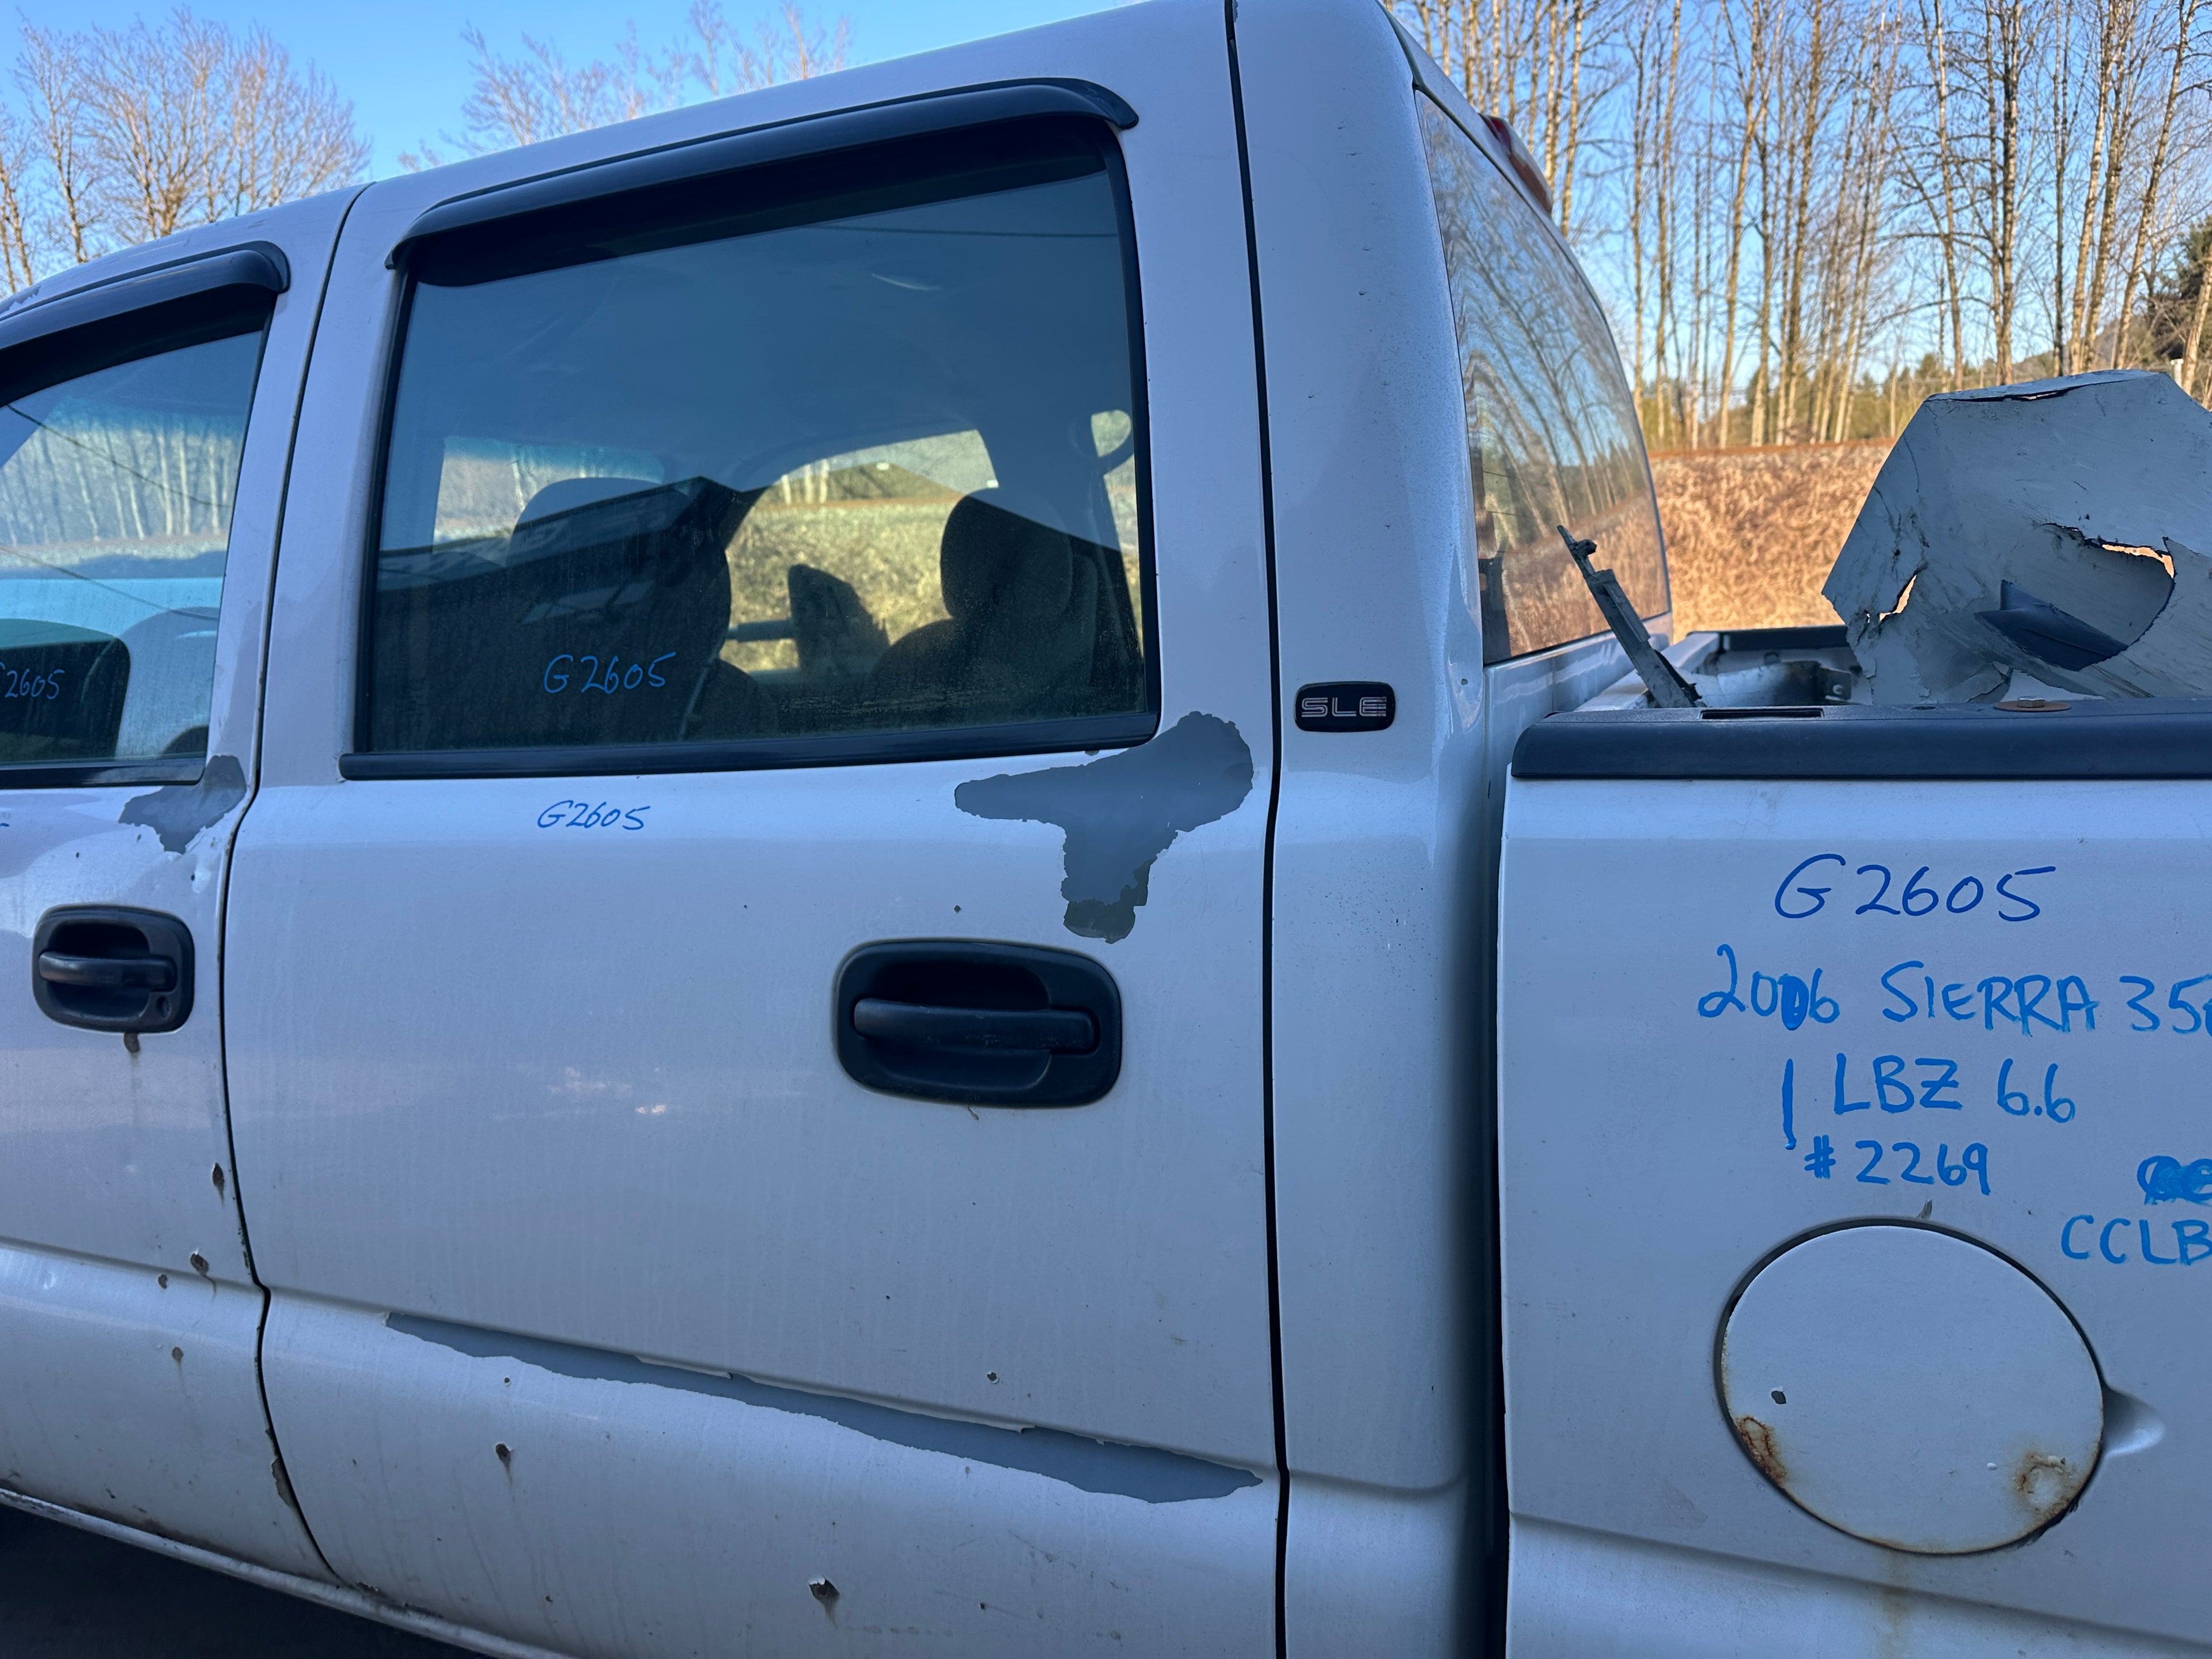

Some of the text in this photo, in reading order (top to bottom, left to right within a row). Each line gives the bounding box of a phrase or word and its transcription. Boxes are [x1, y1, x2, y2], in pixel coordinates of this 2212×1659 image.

[0, 662, 65, 699] 2605
[544, 652, 676, 694] G2605
[1301, 696, 1387, 717] SLE
[537, 800, 651, 831] G2605
[1774, 853, 2056, 922] G2605
[1881, 960, 2100, 1037] SIERRA
[1833, 1052, 1964, 1116] LBZ
[1997, 1058, 2075, 1123] 6.6
[2061, 1215, 2212, 1266] CCLB
